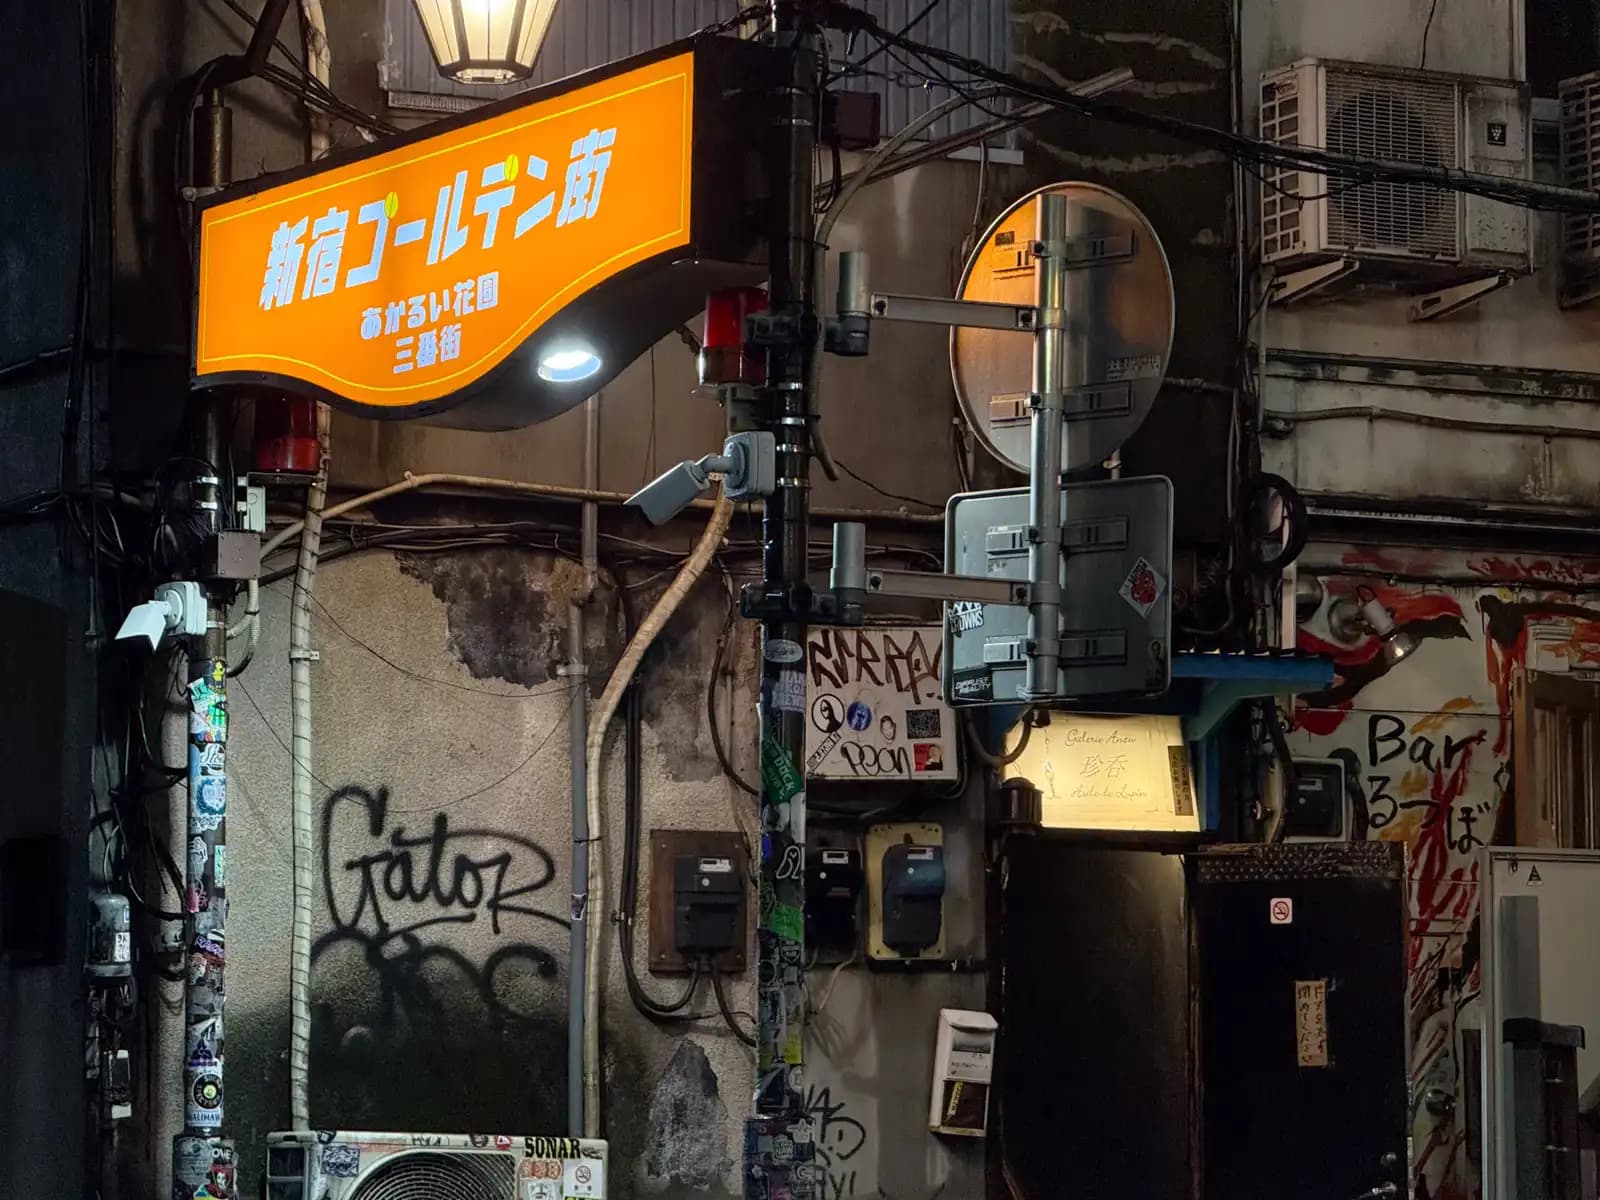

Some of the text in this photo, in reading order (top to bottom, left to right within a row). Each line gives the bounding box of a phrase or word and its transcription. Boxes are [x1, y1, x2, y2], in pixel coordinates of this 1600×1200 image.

[360, 270, 499, 340] あかるい花園
[392, 322, 462, 374] 三番街
[1368, 713, 1486, 773] Bar
[525, 1136, 581, 1159] SONAR
